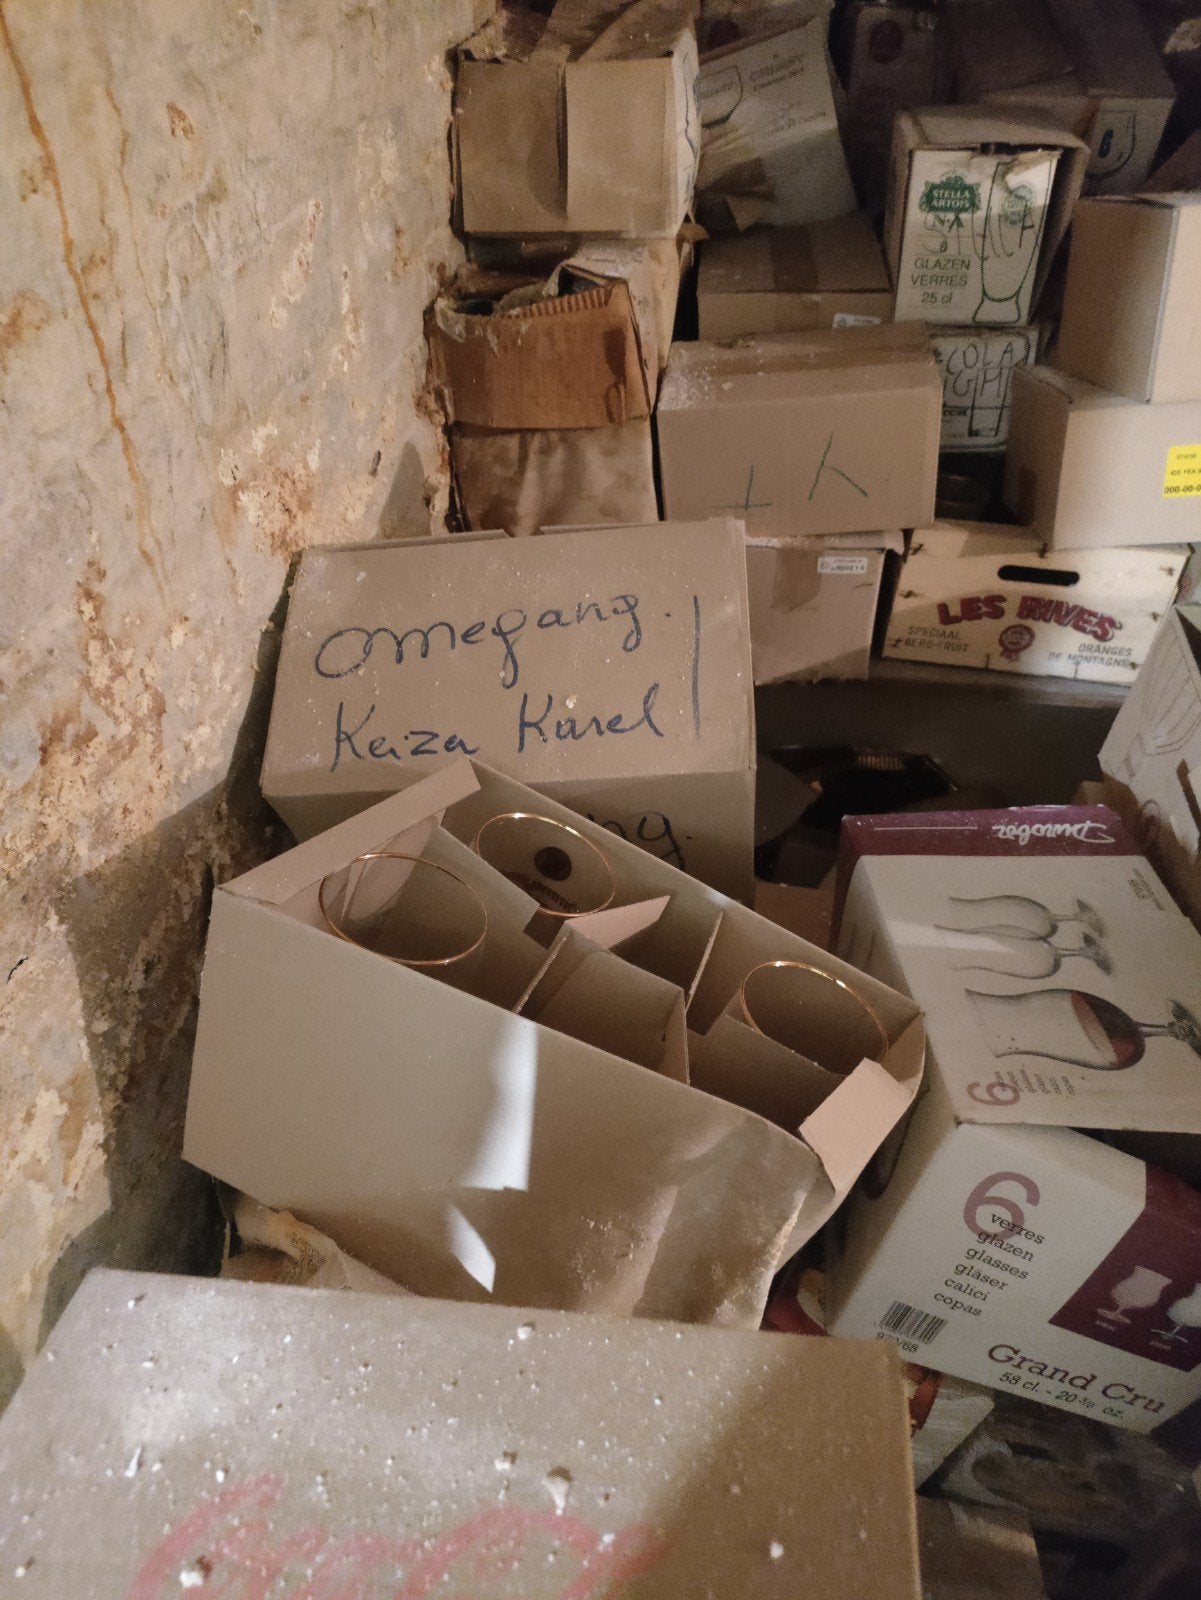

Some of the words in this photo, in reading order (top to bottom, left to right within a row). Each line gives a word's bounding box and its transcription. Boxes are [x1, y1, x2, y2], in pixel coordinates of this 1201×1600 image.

[914, 258, 971, 271] GLAZEN
[911, 274, 968, 287] VERRES
[921, 292, 938, 304] 25
[937, 594, 1007, 626] LES
[1015, 595, 1123, 643] RIVES
[907, 625, 961, 641] SPECIAAL
[1078, 643, 1133, 657] ORANGES
[518, 682, 665, 753] Karel
[963, 1171, 1040, 1241] 6
[991, 1213, 1046, 1245] verres
[976, 1231, 1034, 1262] glazen
[964, 1248, 1029, 1280] glasses
[944, 1277, 991, 1302] calici
[933, 1293, 982, 1317] copas
[987, 1344, 1098, 1391] Grand
[1101, 1382, 1167, 1414] Cru
[999, 1371, 1021, 1386] 58
